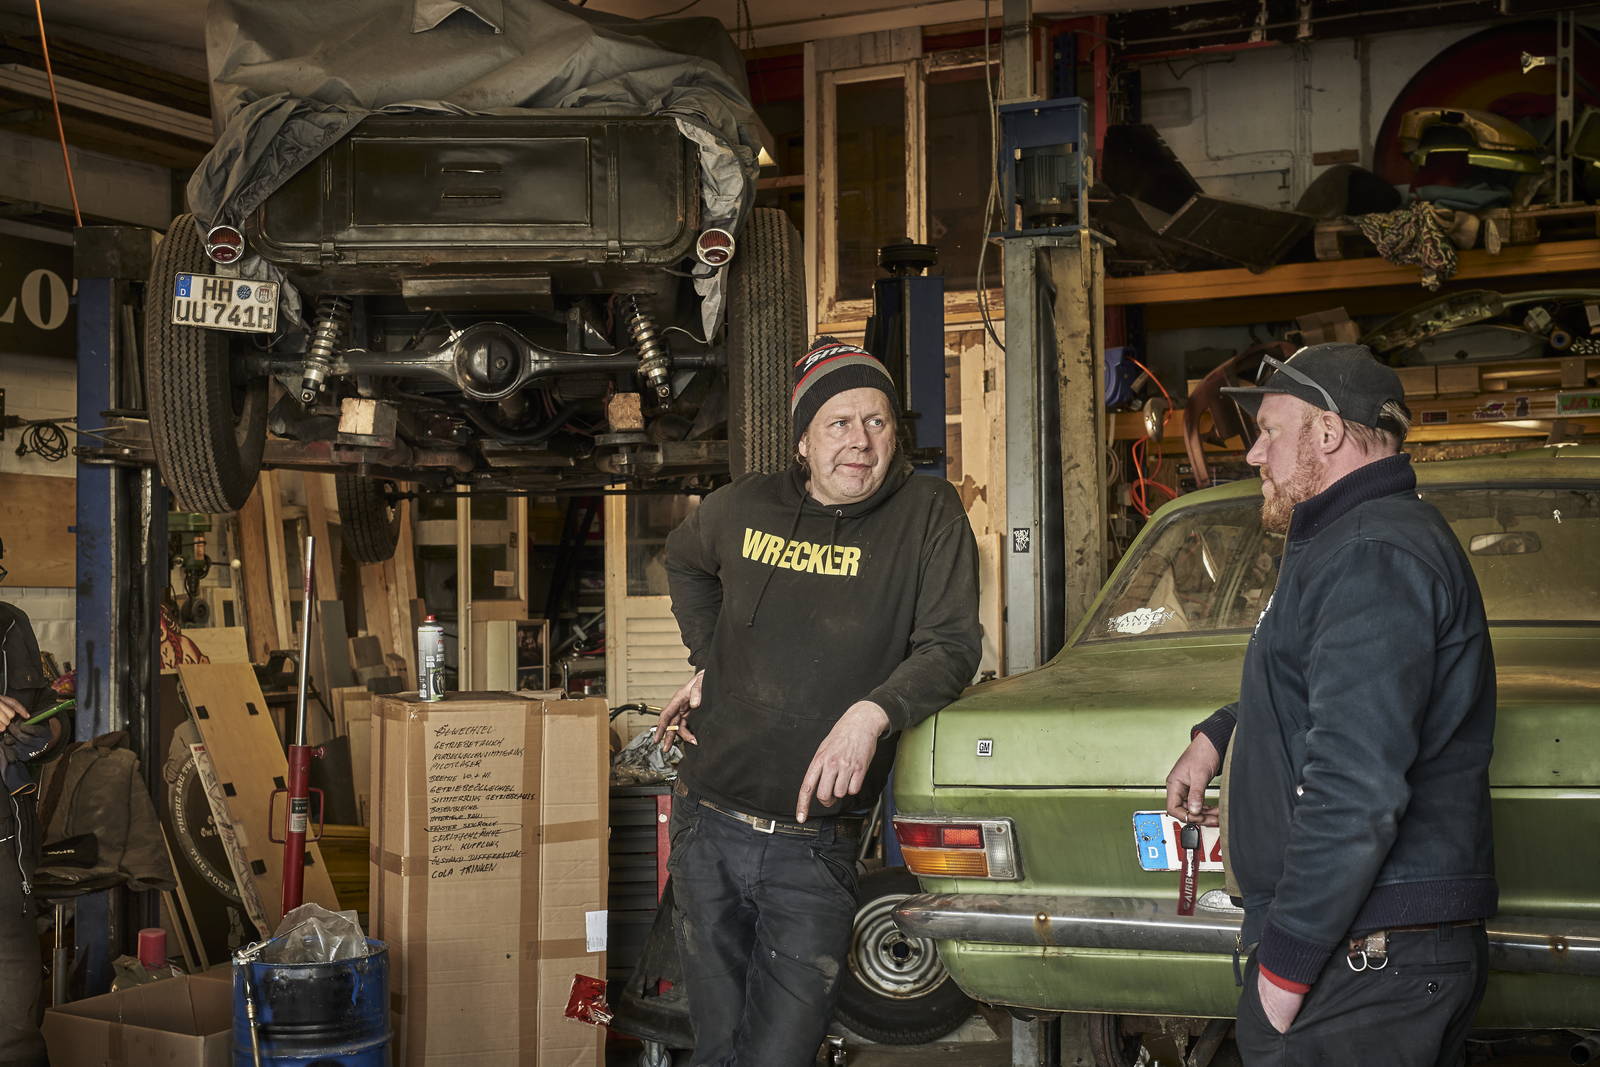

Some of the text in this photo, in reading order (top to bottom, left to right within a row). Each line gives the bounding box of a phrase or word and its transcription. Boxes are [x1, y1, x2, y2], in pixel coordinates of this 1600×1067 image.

[180, 278, 233, 302] D HH
[176, 299, 273, 329] UU 741H
[742, 528, 861, 576] WRECKER
[979, 742, 990, 751] GM
[176, 774, 185, 794] ARE
[1147, 846, 1159, 859] D
[190, 848, 207, 871] THE
[206, 870, 229, 892] POET
[431, 863, 498, 879] COLA TRINKEN
